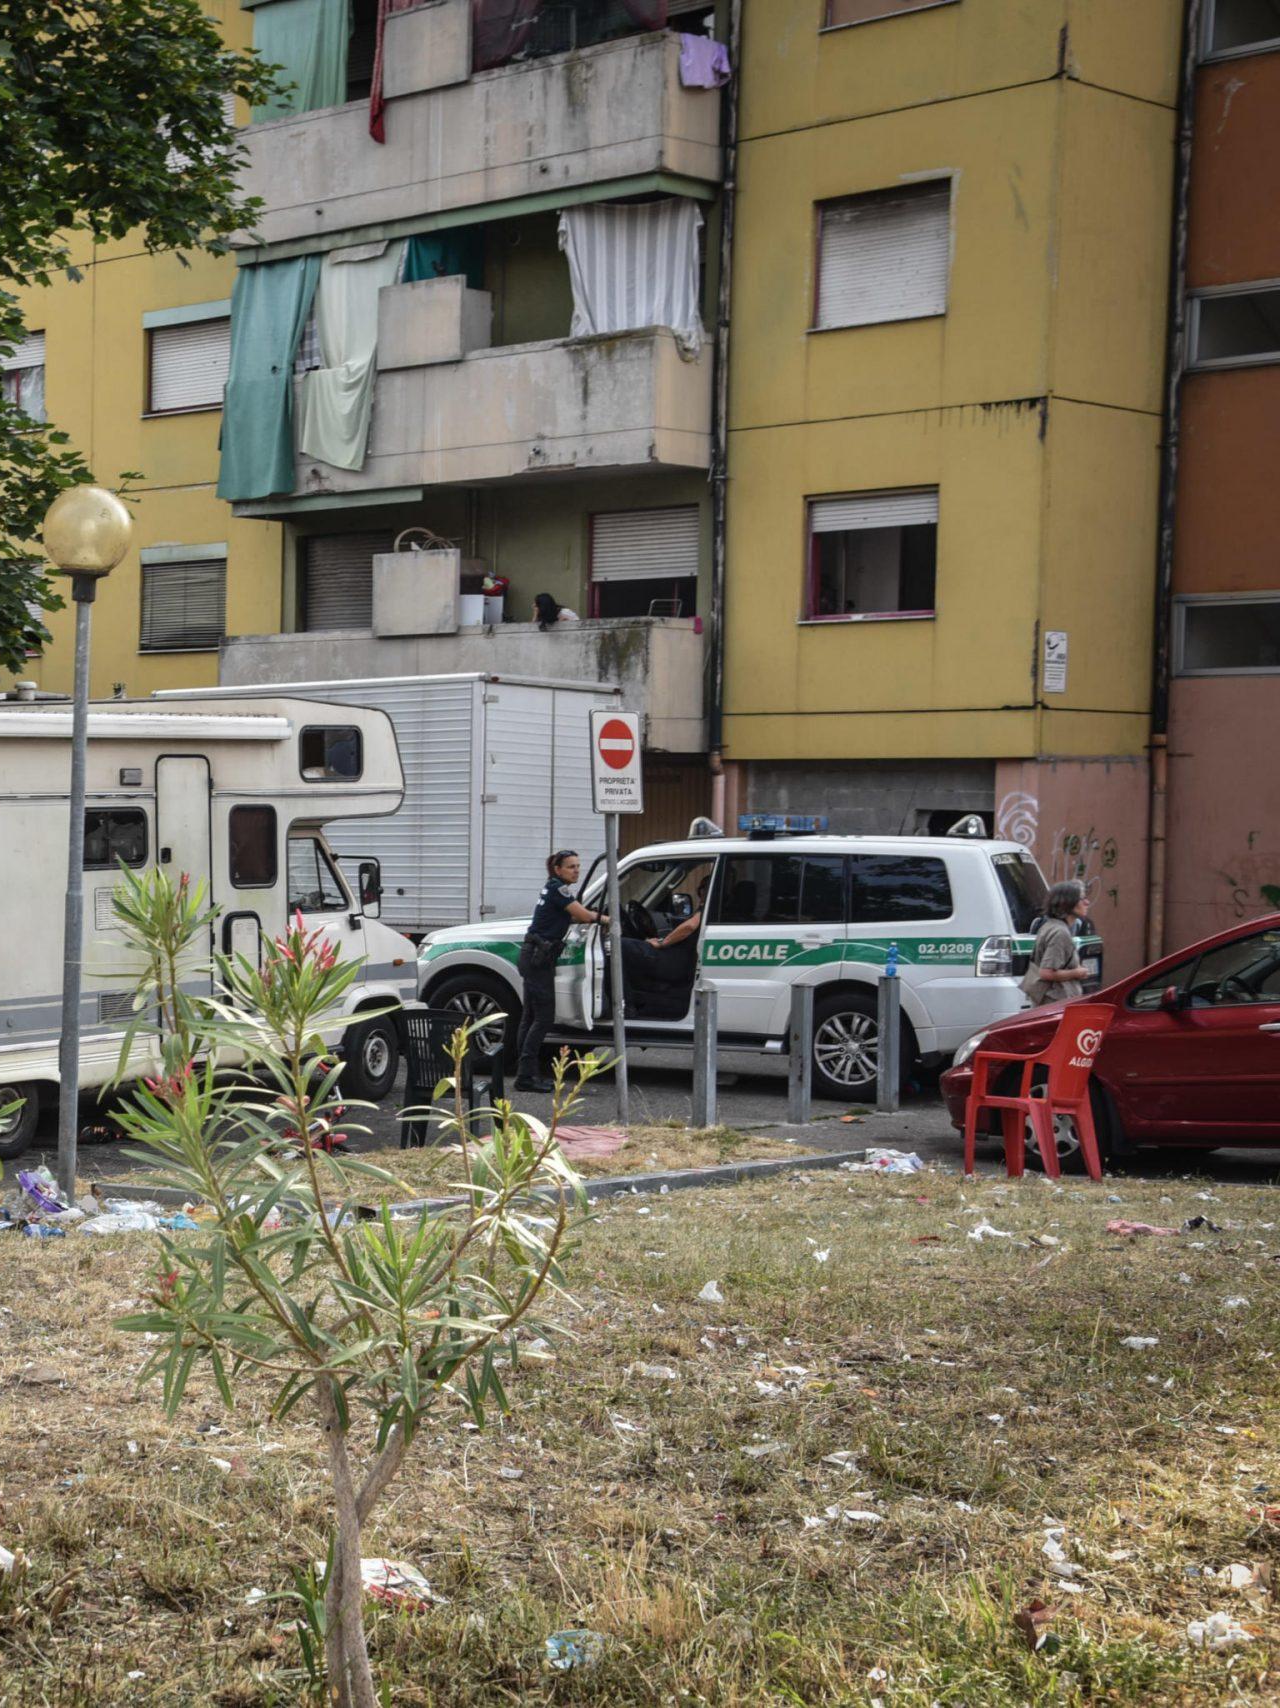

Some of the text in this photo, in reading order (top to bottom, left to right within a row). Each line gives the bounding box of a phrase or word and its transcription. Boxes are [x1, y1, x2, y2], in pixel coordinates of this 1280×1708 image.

[604, 788, 633, 796] PRIVATA
[706, 944, 789, 960] LOCALE
[918, 943, 974, 954] 02.0208
